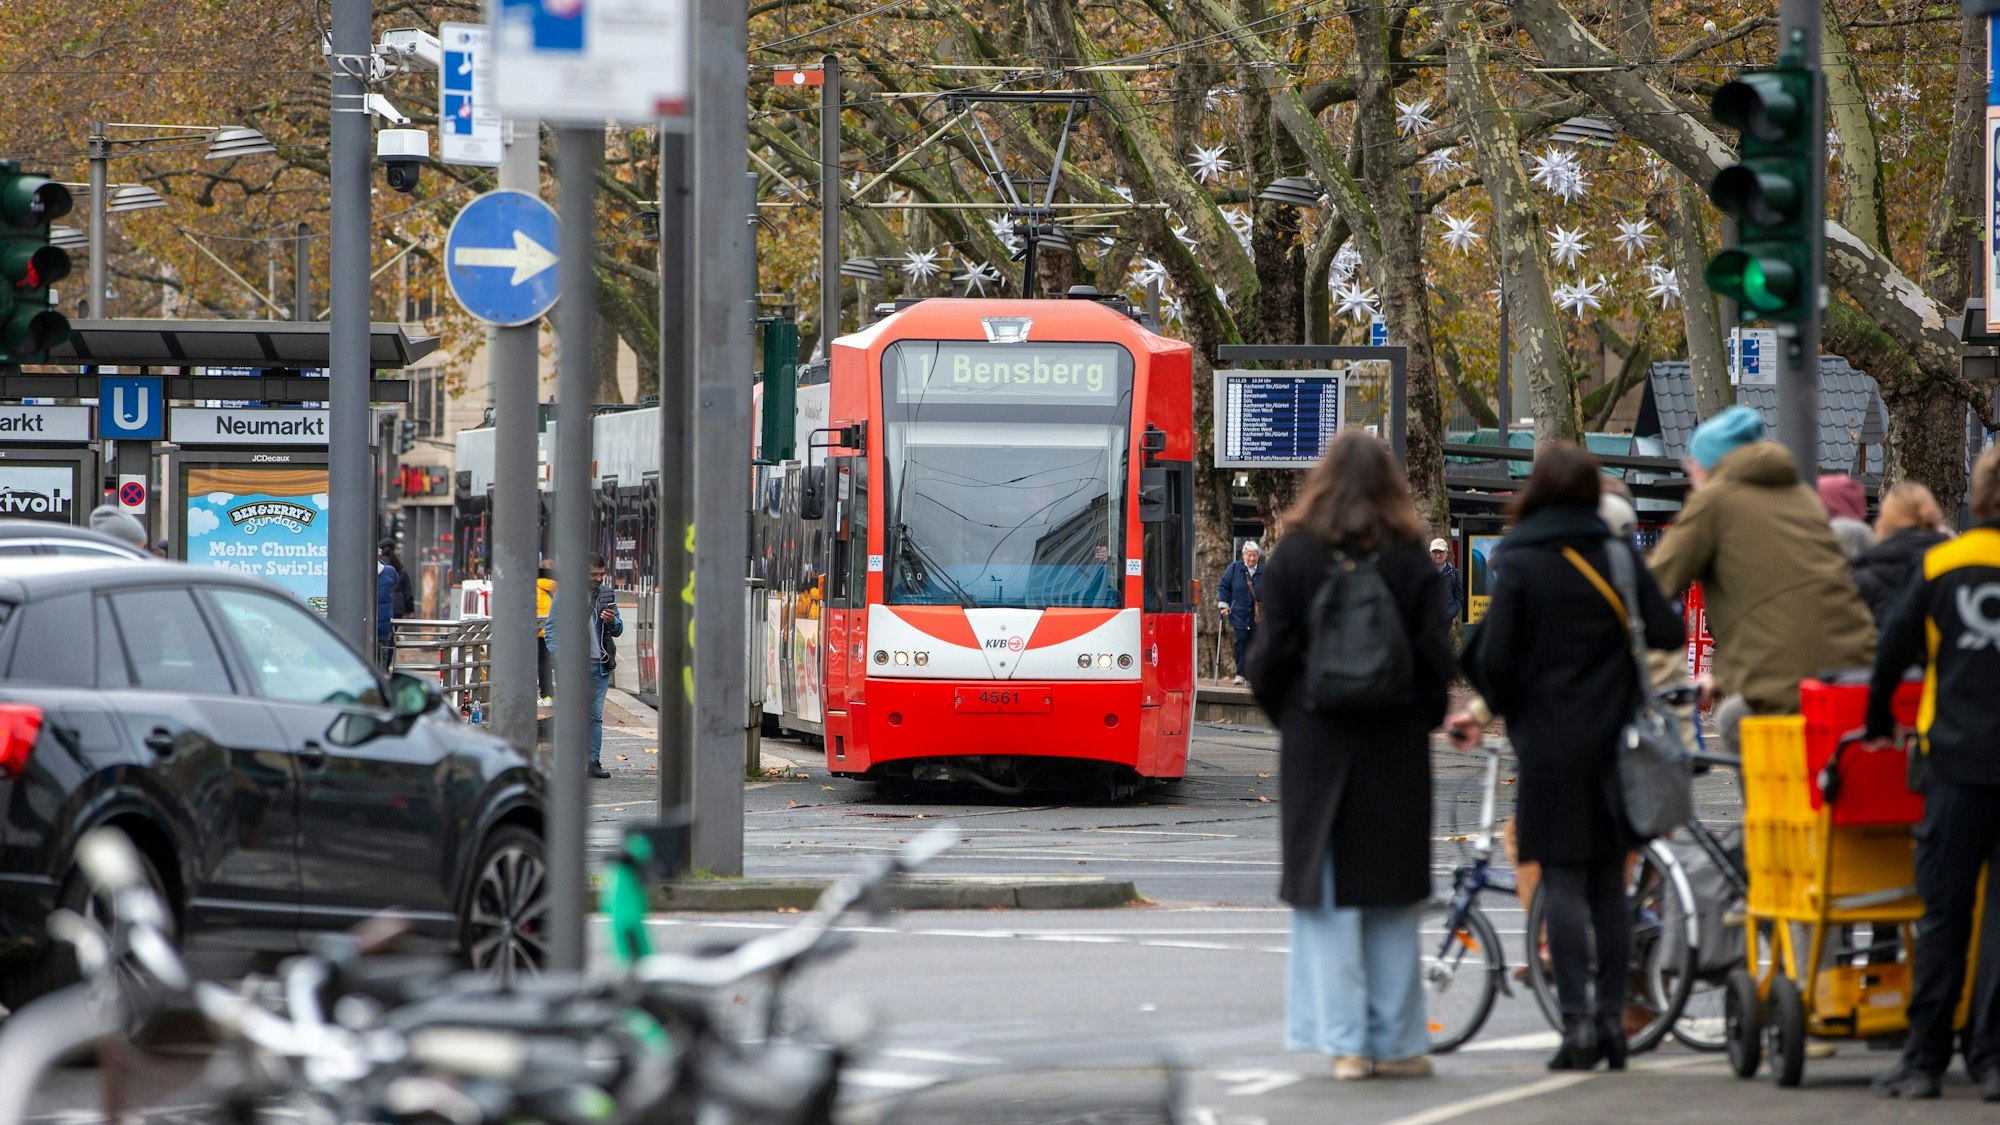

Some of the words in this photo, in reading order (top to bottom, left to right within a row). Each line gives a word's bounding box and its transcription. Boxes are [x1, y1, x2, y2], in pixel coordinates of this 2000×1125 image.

[919, 353, 929, 390] 1
[953, 353, 1104, 392] Bensberg
[113, 387, 149, 431] U
[216, 415, 325, 435] Neumarkt
[251, 454, 290, 463] JCDecaux
[244, 514, 303, 535] Sundae
[209, 541, 258, 557] Mehr
[261, 541, 328, 557] Chunks
[213, 560, 262, 576] Mehr
[265, 560, 328, 576] Swirls!
[985, 639, 1008, 649] KVB
[979, 690, 1020, 705] 4561
